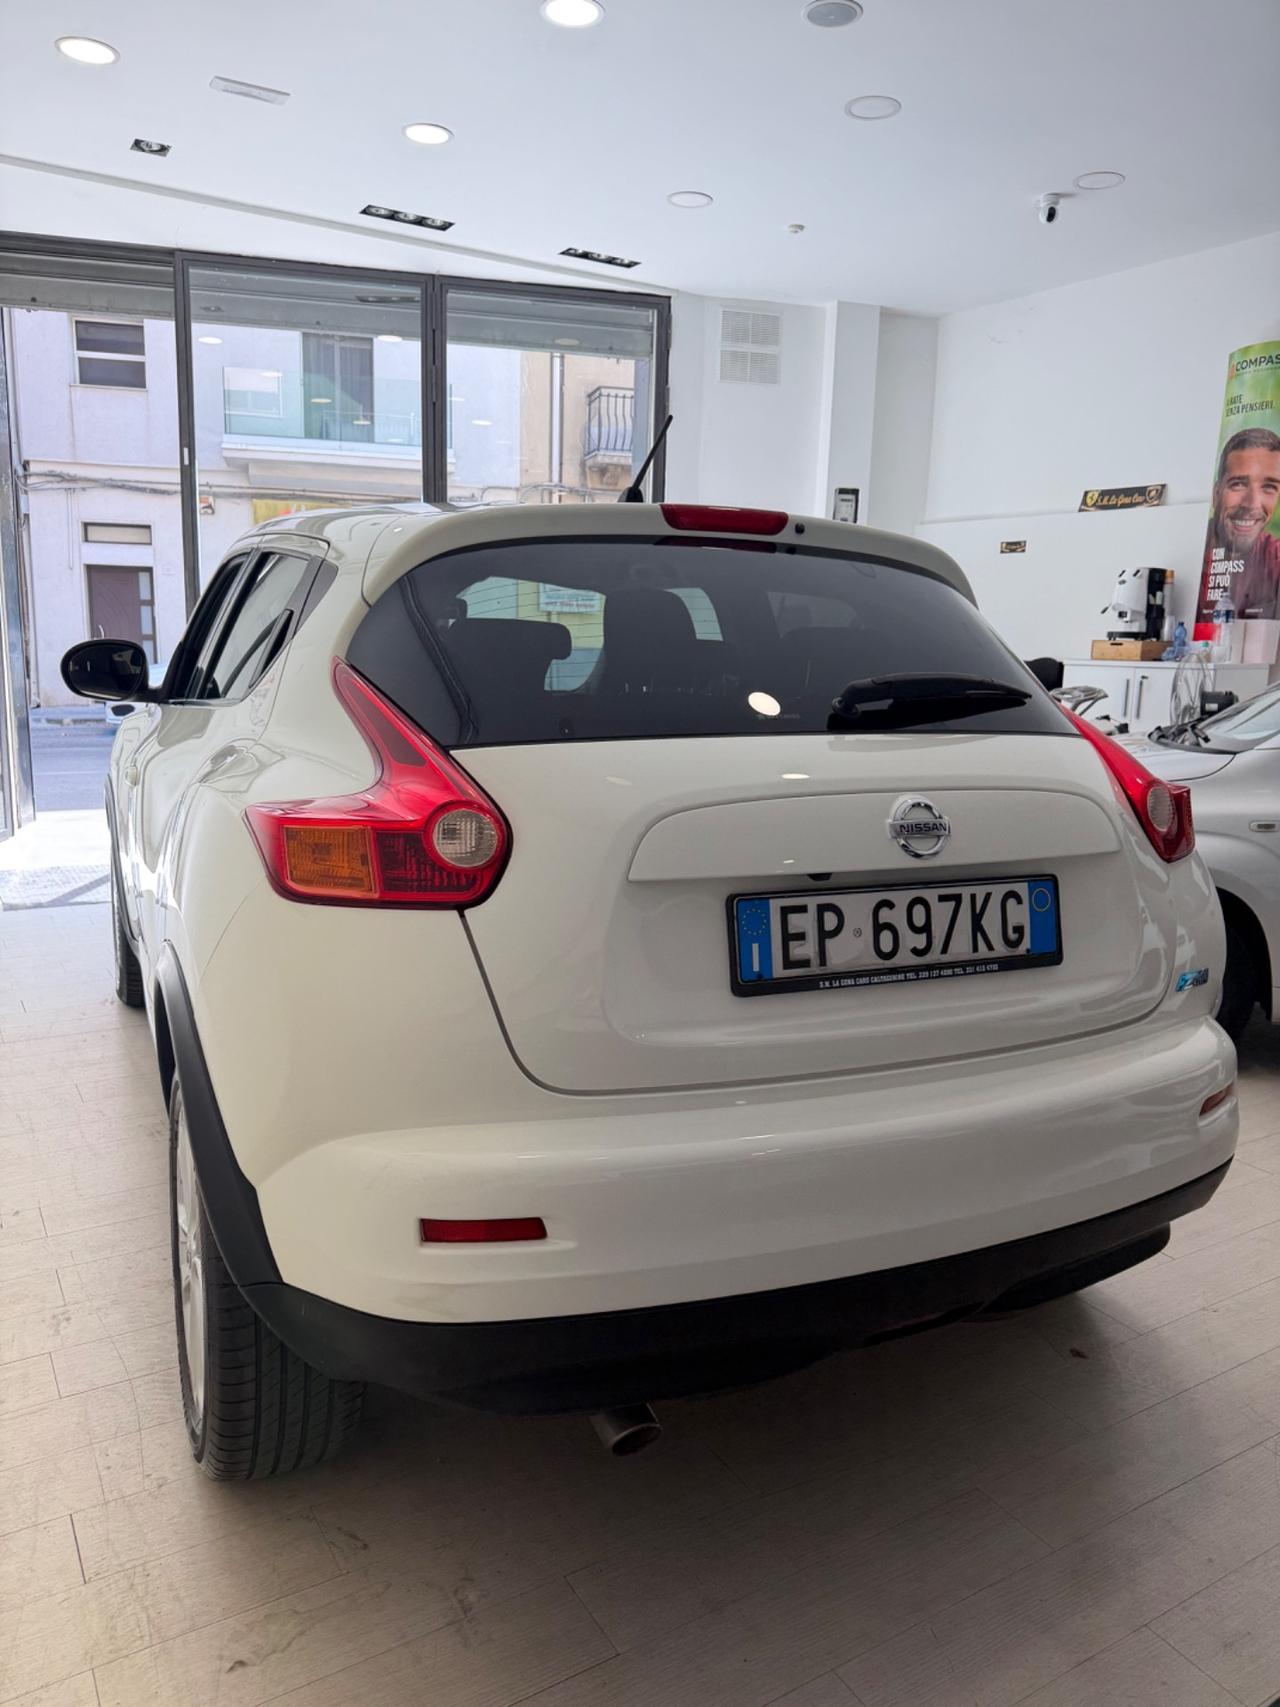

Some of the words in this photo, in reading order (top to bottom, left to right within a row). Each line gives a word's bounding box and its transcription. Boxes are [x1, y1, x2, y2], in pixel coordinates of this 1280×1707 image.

[1212, 547, 1226, 560] CON
[1210, 560, 1245, 574] COMPASS
[1208, 575, 1216, 587] SI
[899, 822, 947, 833] NISSAN
[779, 902, 846, 971] EP
[871, 890, 1026, 961] 697KG
